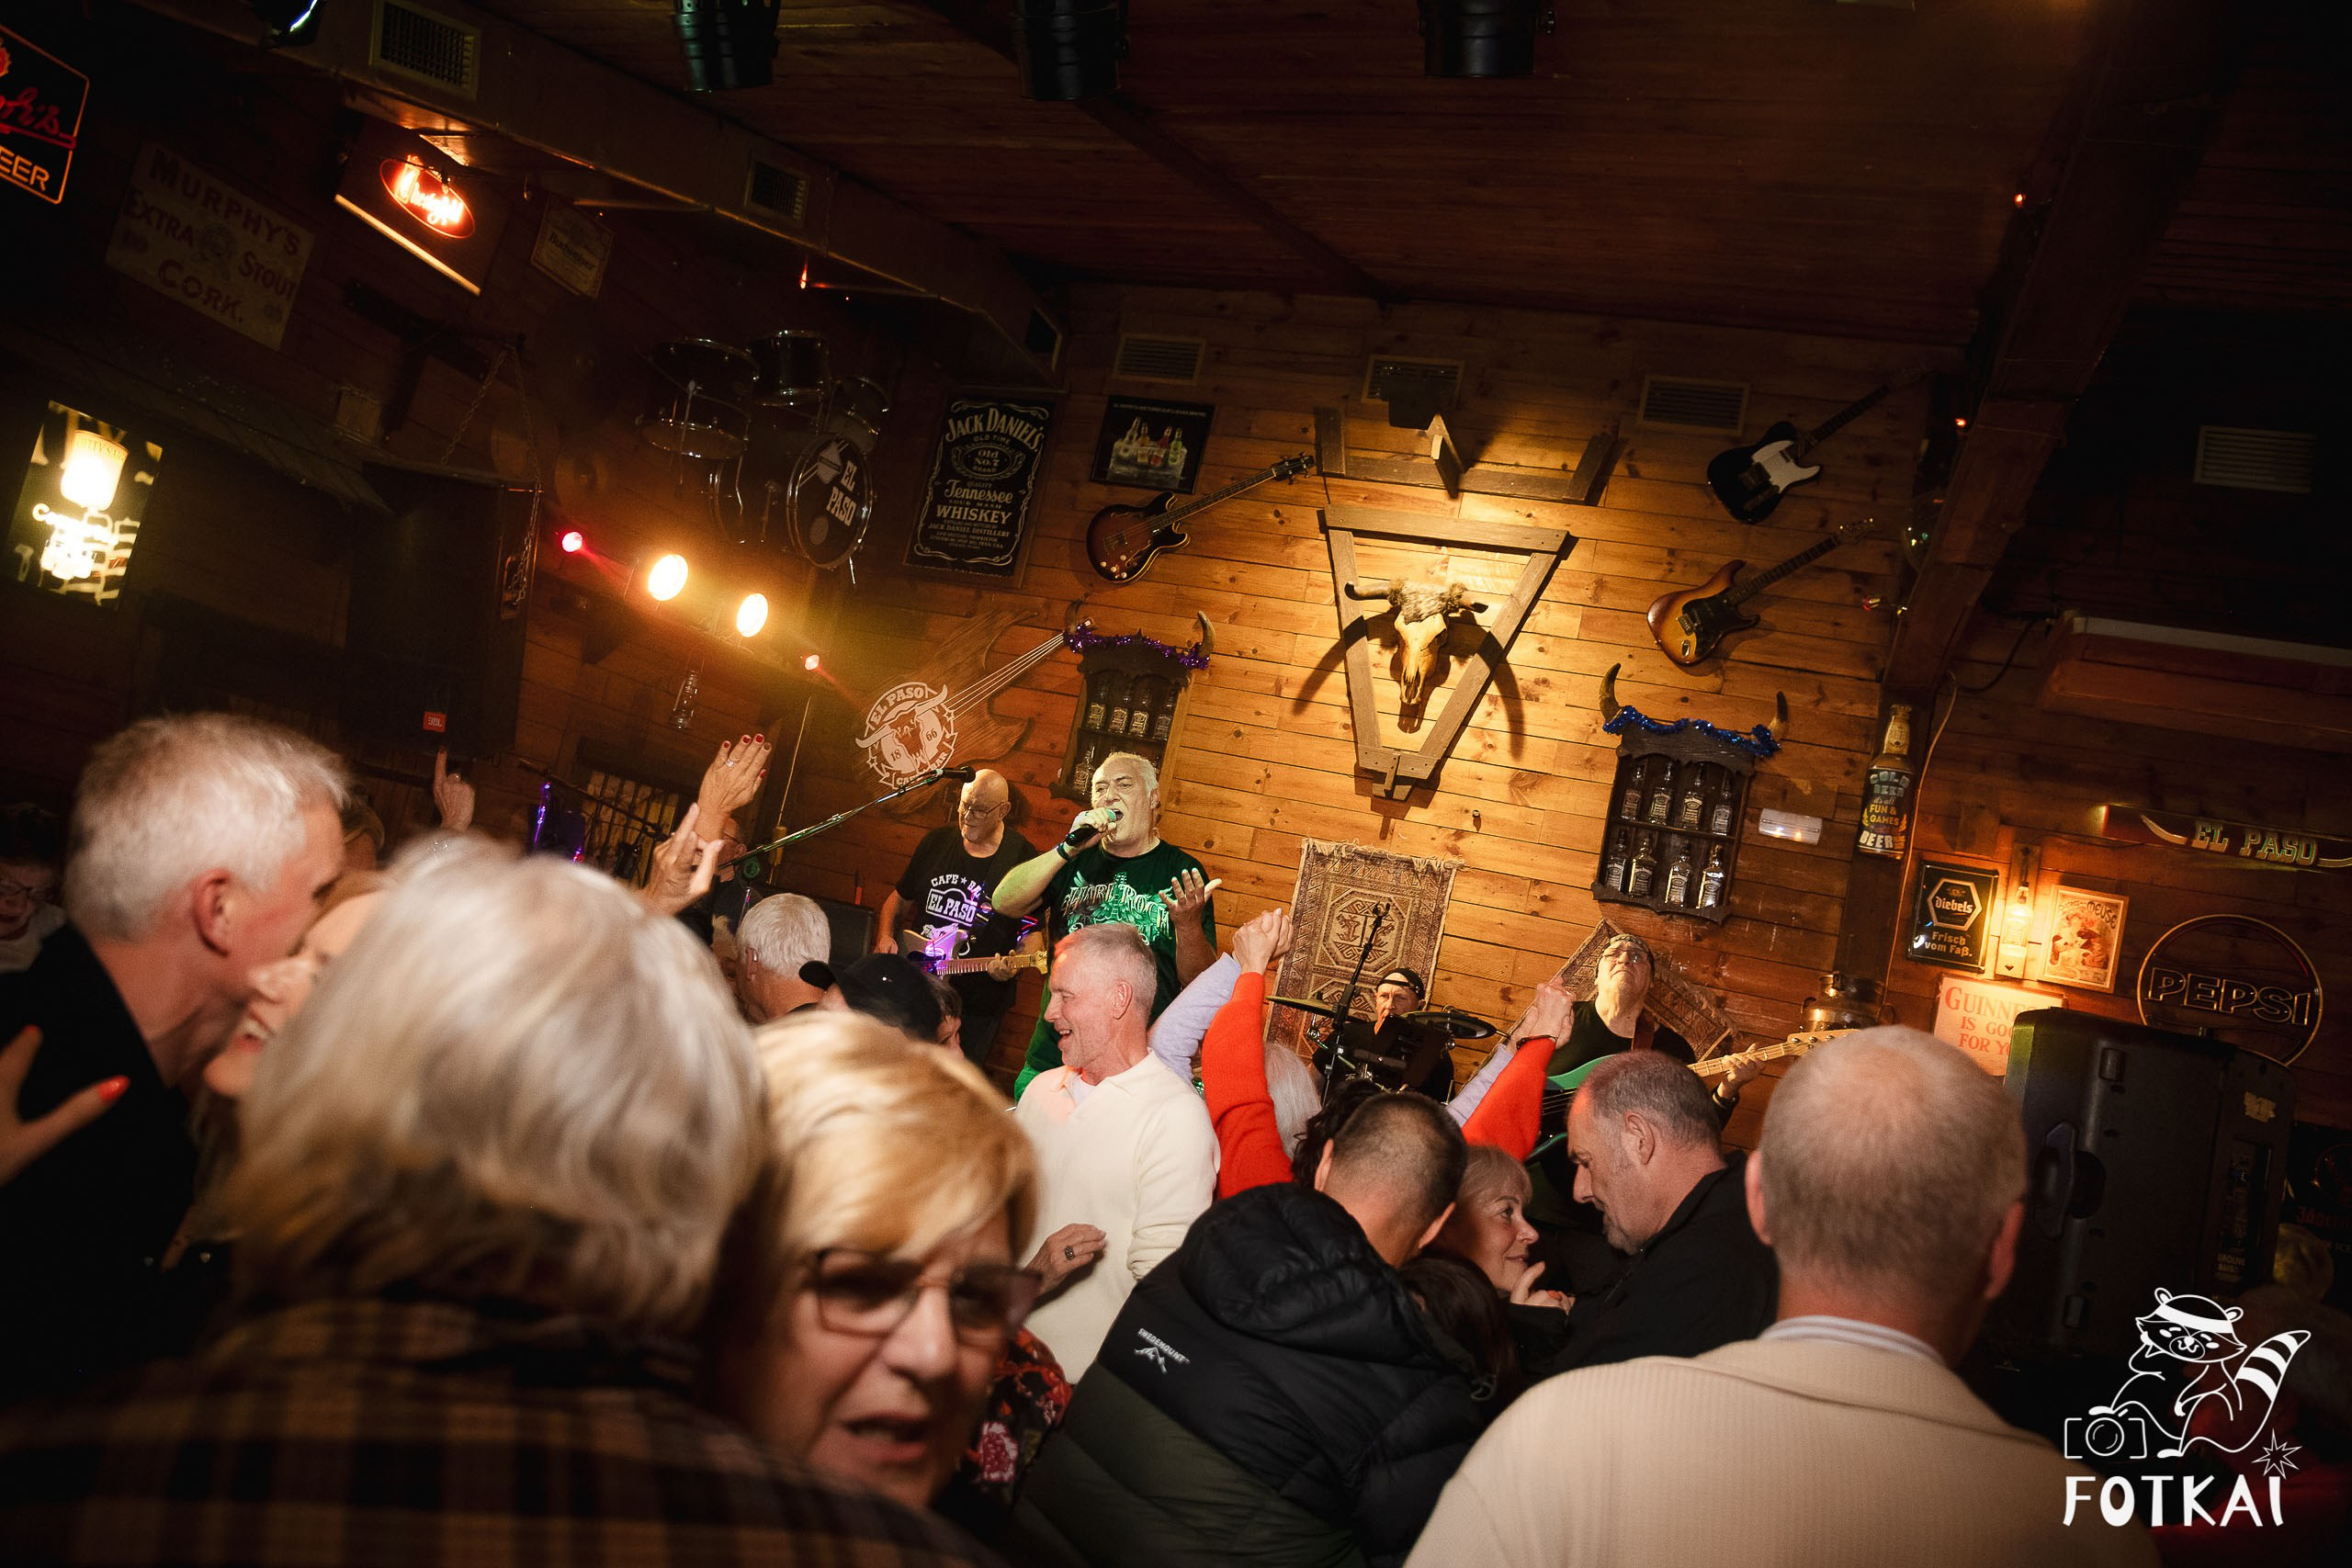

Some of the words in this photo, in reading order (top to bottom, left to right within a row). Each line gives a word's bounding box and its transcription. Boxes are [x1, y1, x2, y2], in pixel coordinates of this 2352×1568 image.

[0, 145, 51, 192] EER
[150, 149, 300, 254] MURPHY'S
[124, 188, 193, 248] EXTRA
[238, 252, 296, 301] STOUT
[945, 414, 984, 442] JACK
[978, 448, 999, 459] Old
[841, 460, 858, 492] EL
[944, 479, 1013, 504] Tennessee
[826, 486, 858, 526] PASO
[936, 505, 1012, 525] WHISKEY
[870, 705, 888, 725] EL
[886, 687, 924, 706] PASO
[890, 749, 902, 762] 18
[925, 728, 938, 742] 66
[930, 751, 948, 771] BAR
[1869, 771, 1910, 788] COLD
[1869, 804, 1888, 815] FUN
[1889, 806, 1897, 815] &
[1870, 814, 1899, 826] GAMES
[1859, 829, 1894, 849] BEER
[2191, 820, 2229, 852] EL
[2239, 829, 2318, 866] PASO
[931, 874, 959, 887] CAFE
[967, 880, 983, 900] BA
[928, 893, 944, 913] EL
[944, 897, 976, 922] PASO
[1924, 941, 1946, 953] vom
[1932, 931, 1966, 946] Frisch
[1945, 987, 2032, 1021] GUINNE
[2148, 966, 2311, 1026] PEPSI
[1960, 1016, 1976, 1031] IS
[1985, 1021, 2013, 1037] GO
[1958, 1032, 1991, 1053] FOR
[1138, 1328, 1187, 1364] SWEDEMOUNT
